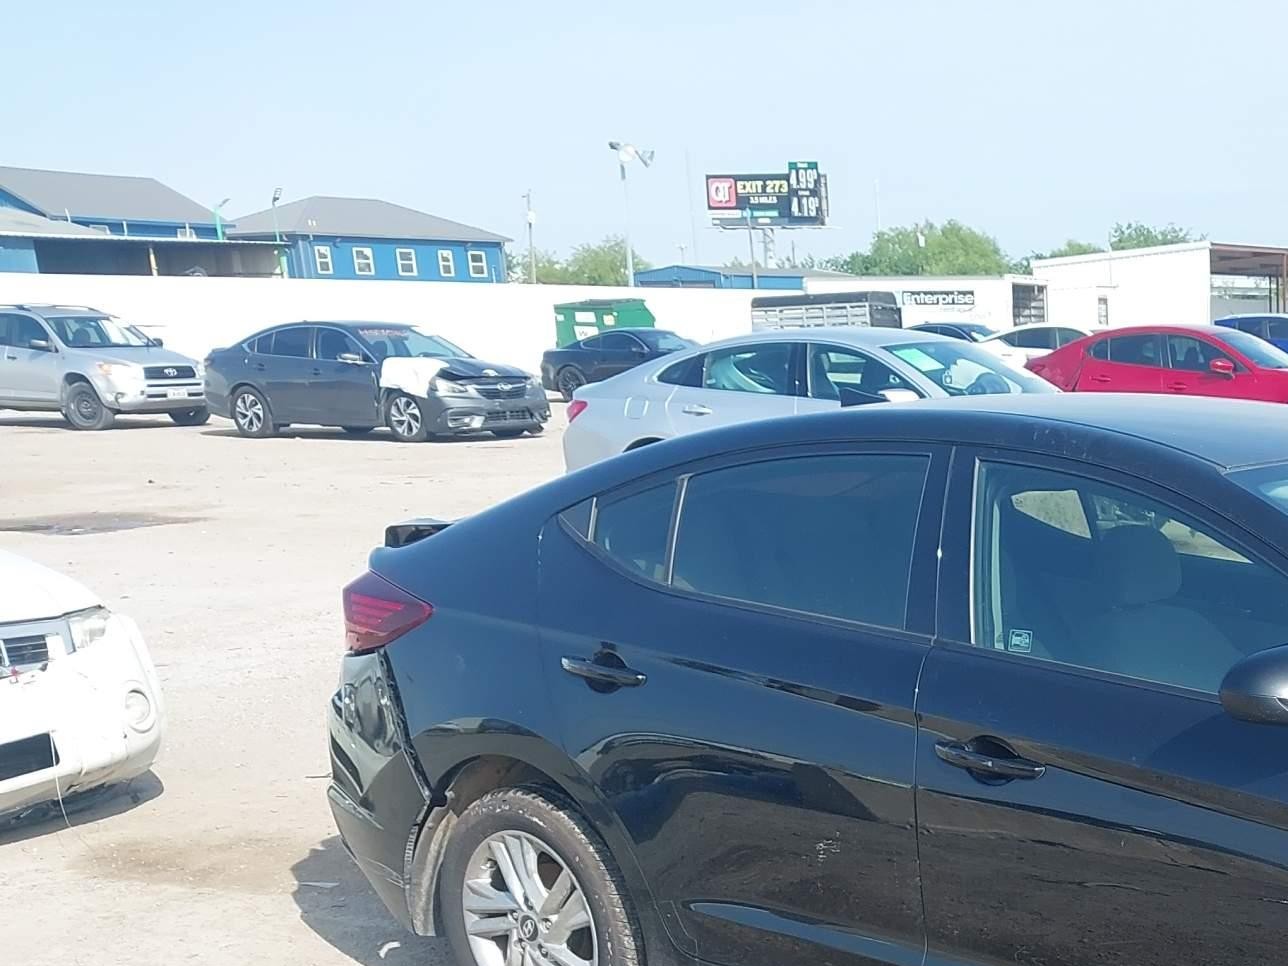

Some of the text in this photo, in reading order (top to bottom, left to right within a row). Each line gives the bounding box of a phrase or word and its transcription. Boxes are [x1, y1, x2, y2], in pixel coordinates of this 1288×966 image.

[710, 182, 733, 204] QT
[737, 181, 763, 193] EXIT
[766, 181, 788, 193] 273
[903, 291, 974, 305] Enterprise
